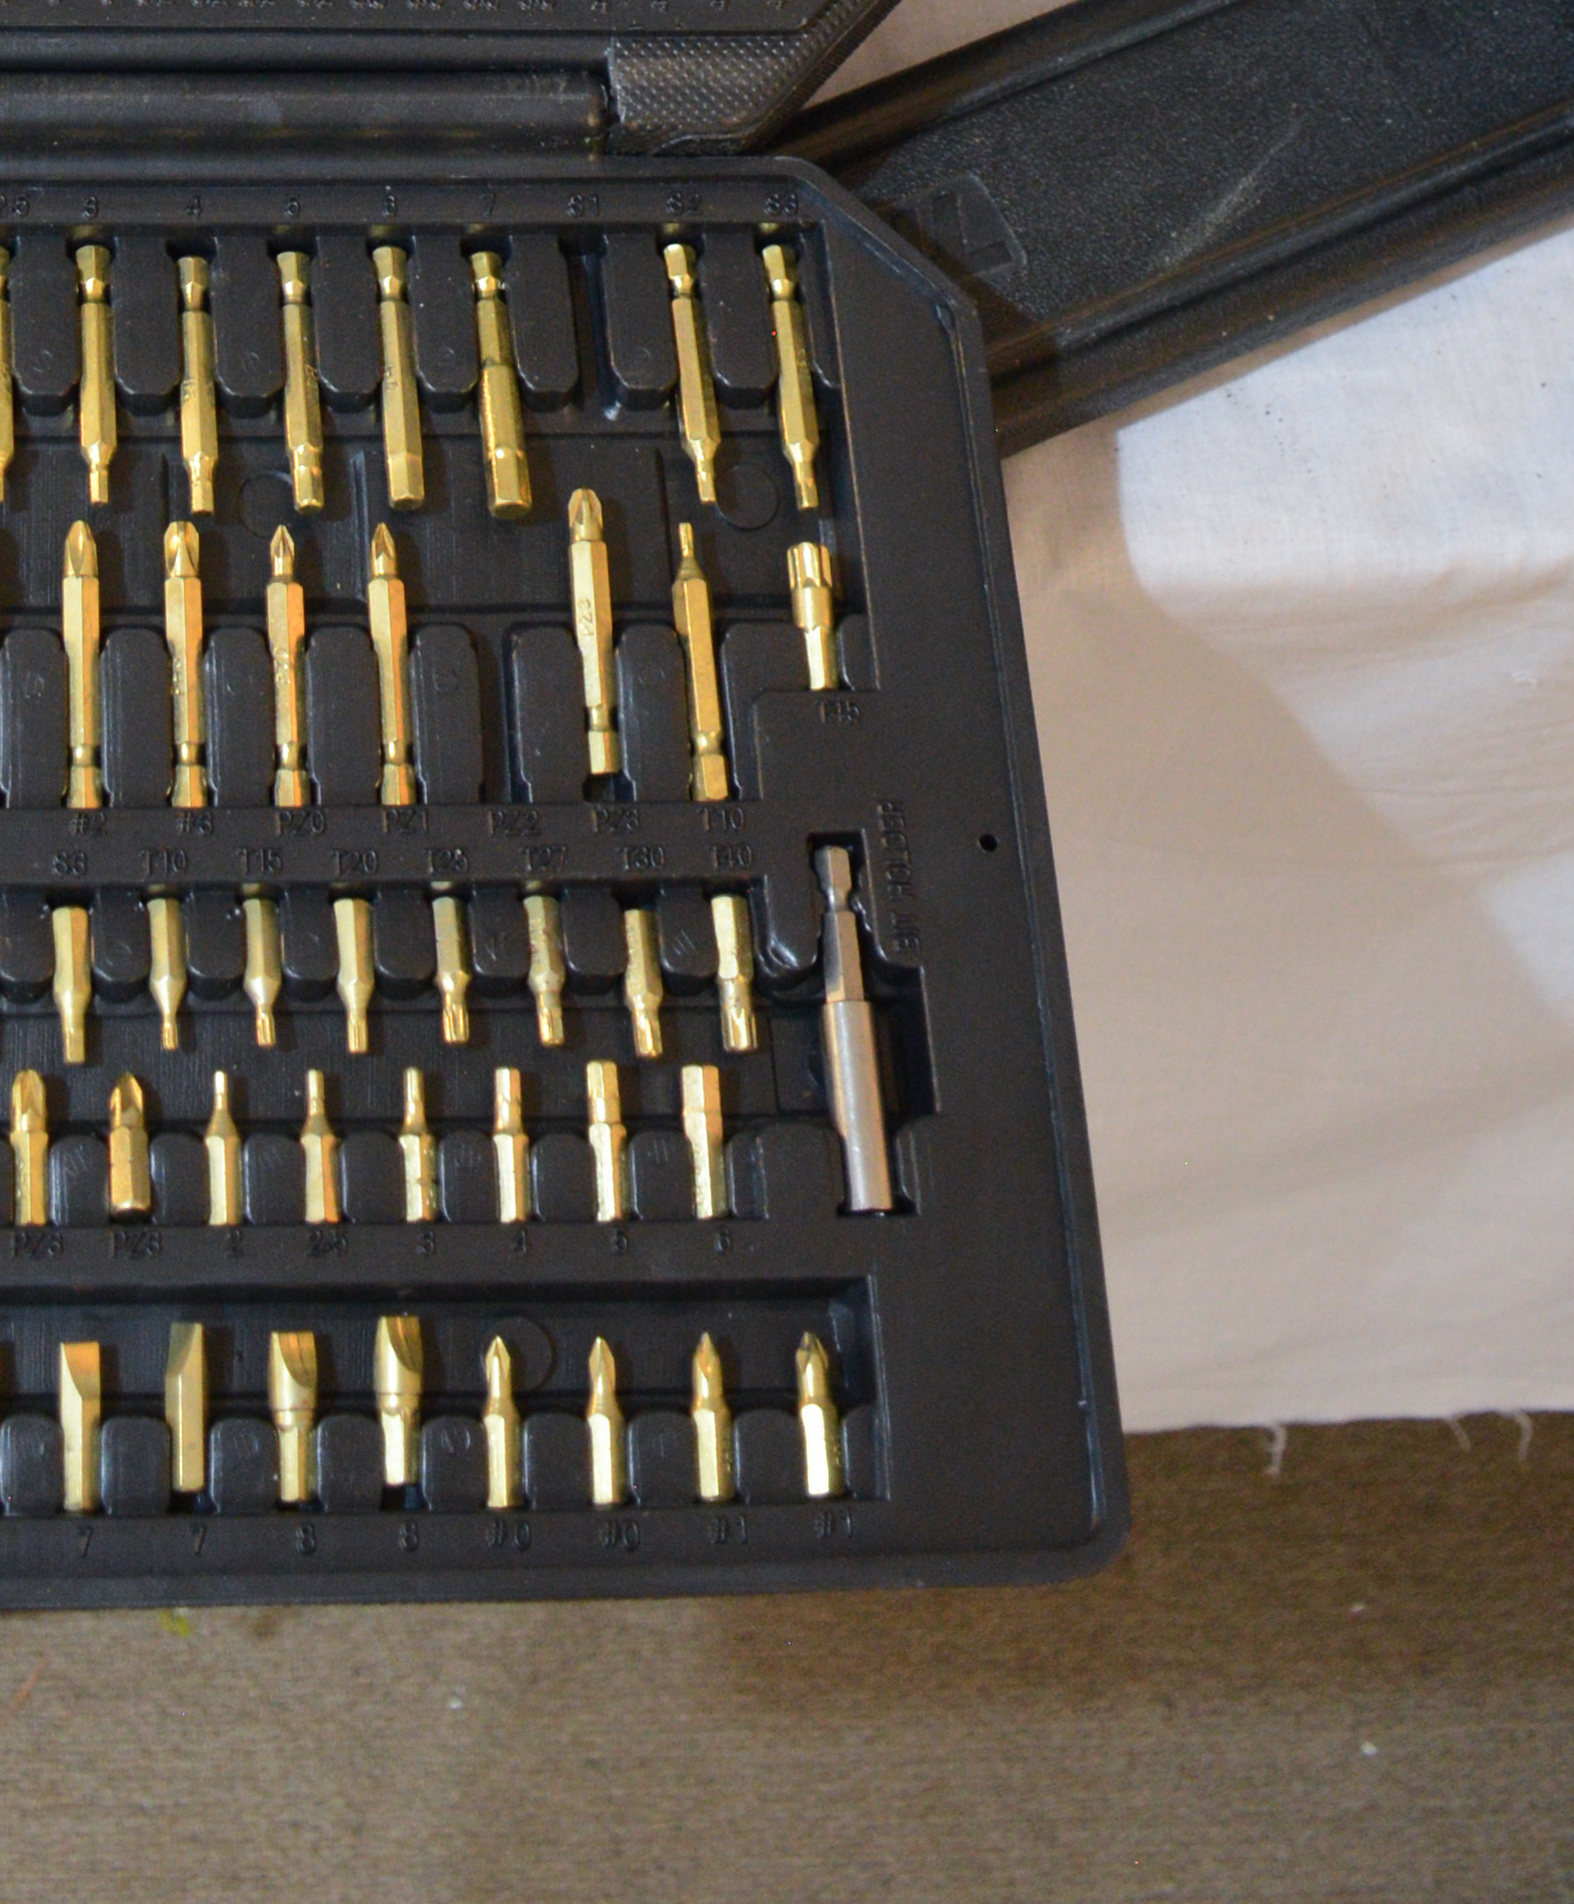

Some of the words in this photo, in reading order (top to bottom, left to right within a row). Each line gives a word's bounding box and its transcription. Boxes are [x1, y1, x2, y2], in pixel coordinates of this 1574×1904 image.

[185, 195, 203, 218] 4
[284, 195, 302, 219] 5
[382, 193, 399, 219] 6
[480, 192, 497, 218] 7
[69, 813, 108, 836] #2
[274, 807, 327, 836] PZ0
[382, 807, 429, 836] PZ1
[487, 807, 539, 837] PZ2
[591, 806, 641, 834] PZ3
[698, 806, 746, 833] T10
[139, 850, 188, 877] T10
[235, 848, 283, 875] T15
[330, 848, 379, 876] T20
[424, 846, 469, 874] T25
[519, 845, 567, 873] T27
[619, 845, 666, 872] T30
[708, 843, 754, 872] T40
[876, 799, 916, 902] HOLDER
[890, 909, 920, 952] BIT
[11, 1229, 64, 1259] PZ3
[111, 1229, 163, 1259] PZ3
[226, 1228, 245, 1259] 2
[307, 1228, 349, 1258] 2.5
[417, 1228, 437, 1256] 3
[513, 1227, 529, 1254] 4
[610, 1227, 630, 1254] 5
[713, 1226, 733, 1255] 6
[76, 1526, 94, 1558] 7
[190, 1526, 207, 1556] 7
[297, 1521, 317, 1556] 8
[398, 1521, 418, 1552] 8
[486, 1520, 532, 1552] #0
[599, 1519, 641, 1553] #0
[707, 1513, 749, 1546] #1
[814, 1511, 854, 1540] #1
